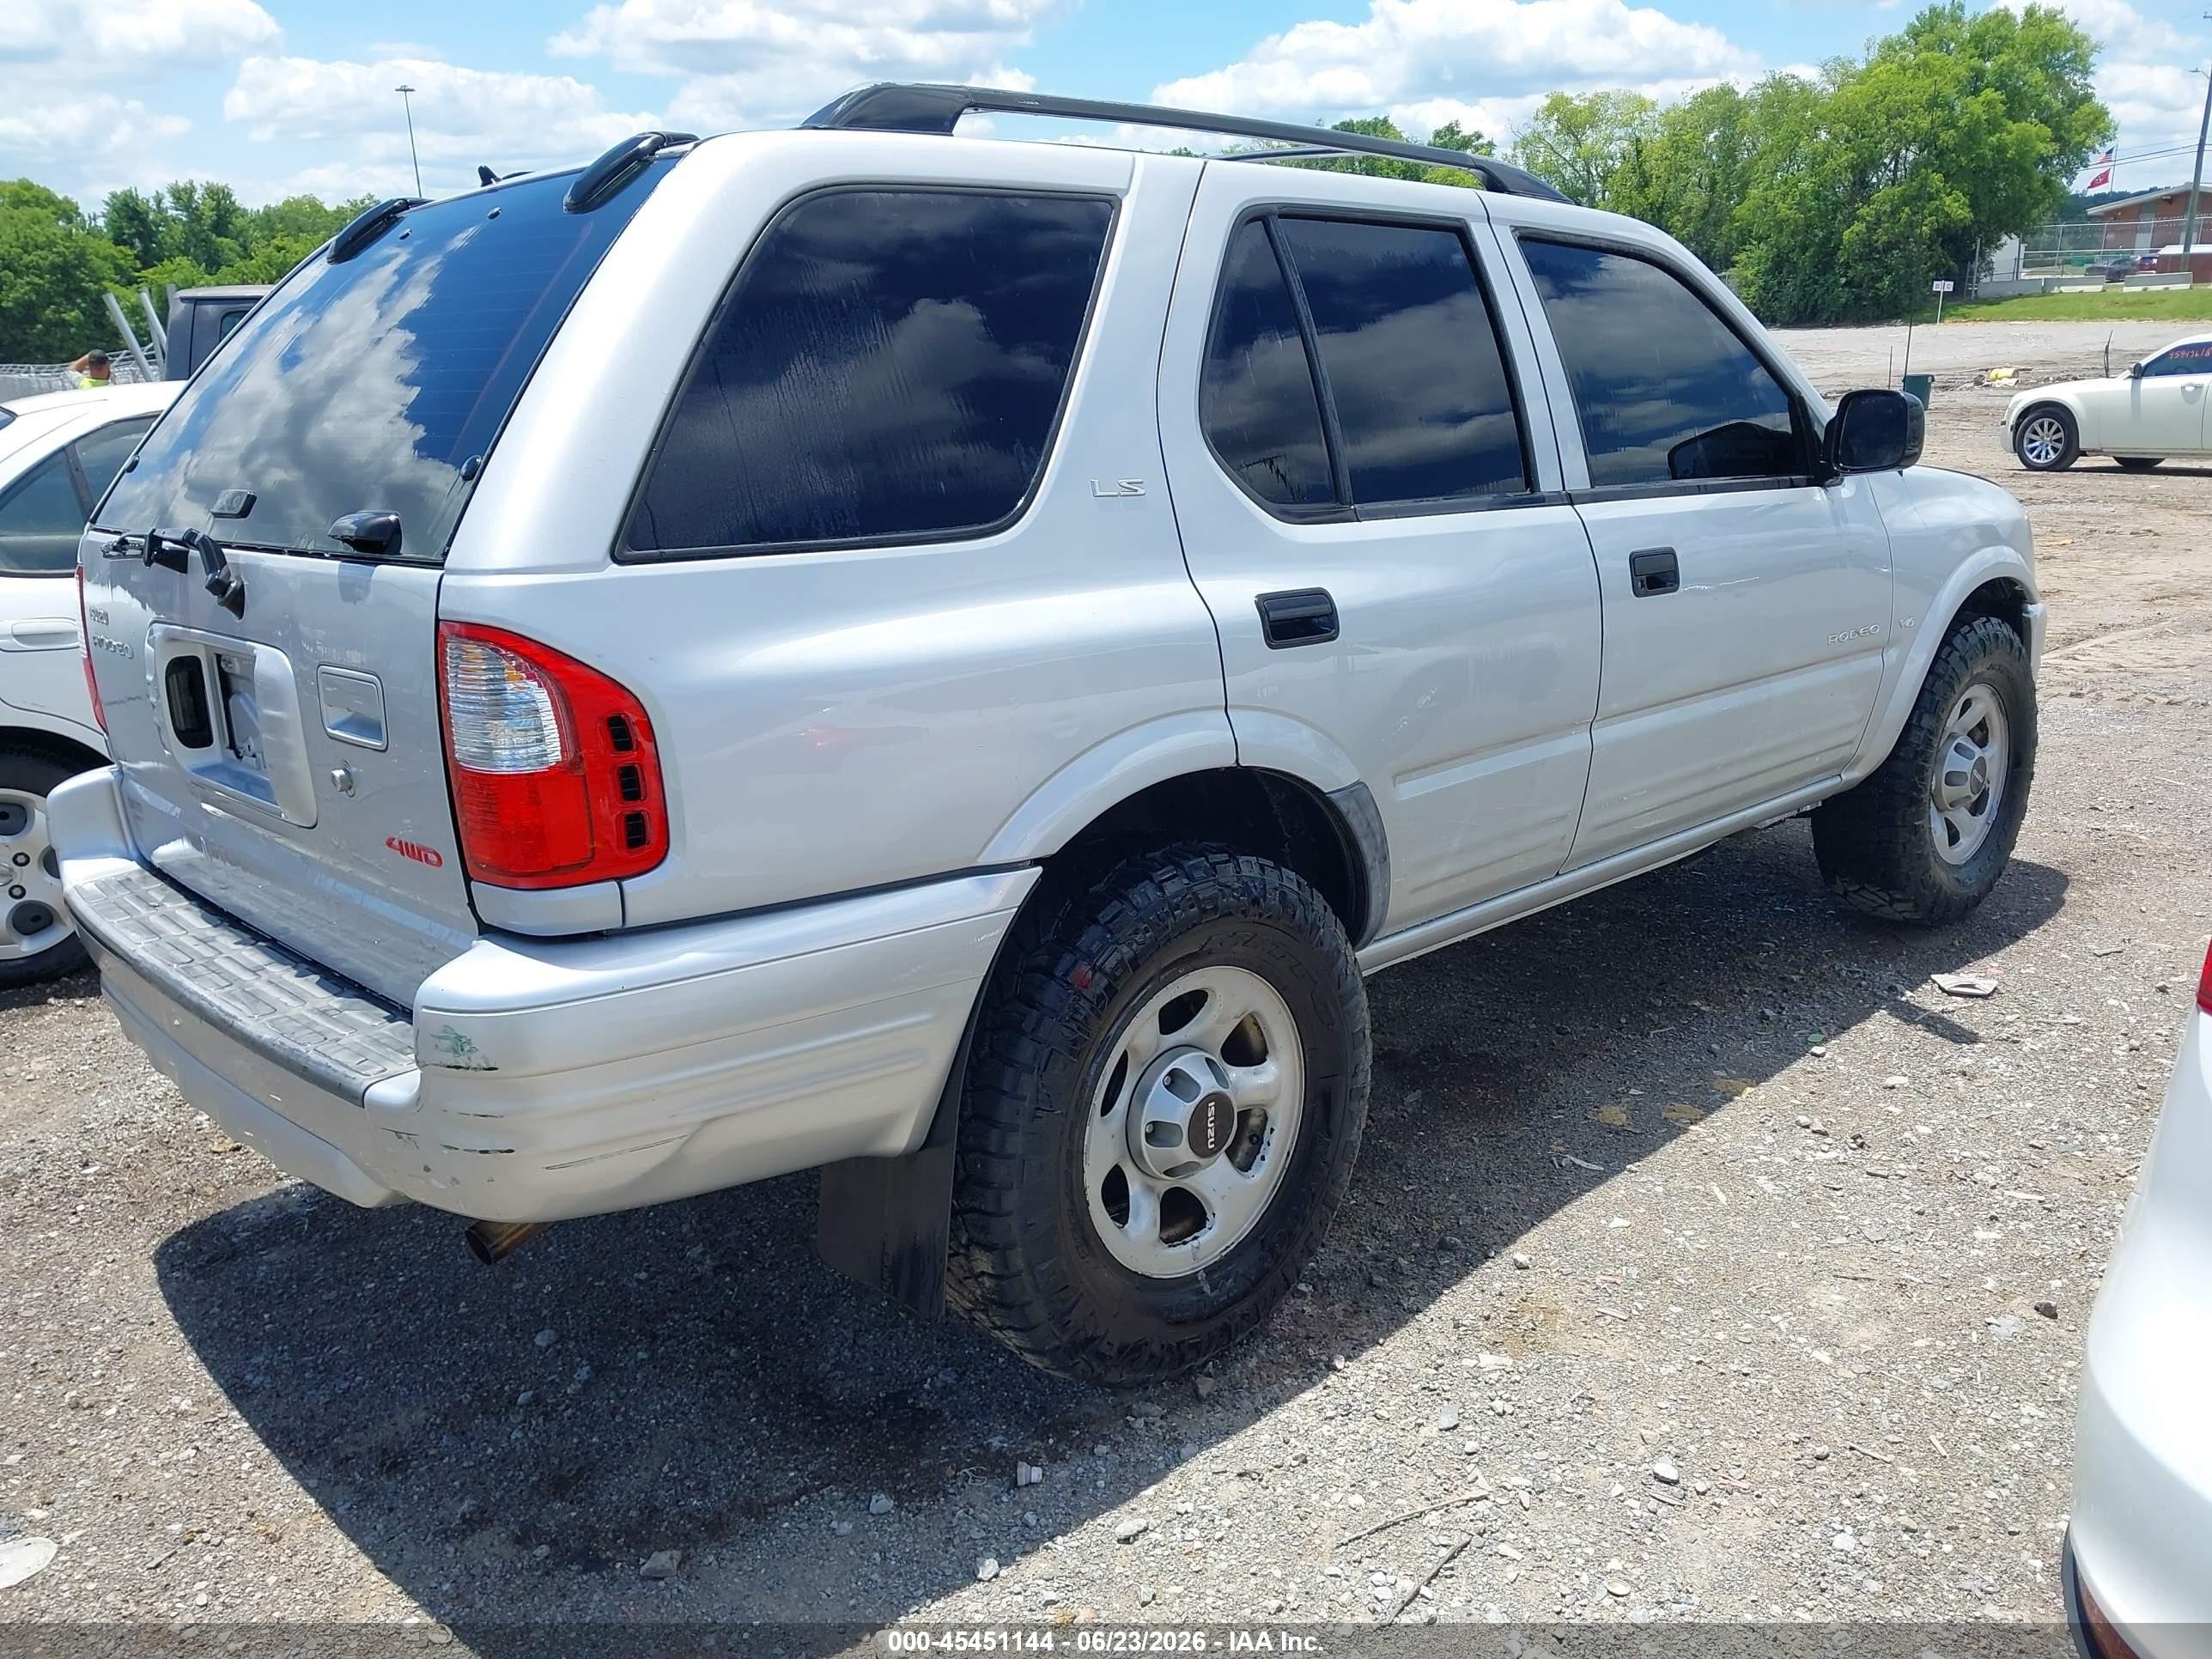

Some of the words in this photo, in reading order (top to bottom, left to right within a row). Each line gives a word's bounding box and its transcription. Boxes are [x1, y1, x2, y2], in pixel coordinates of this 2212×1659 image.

[1090, 477, 1146, 498] LS
[1899, 616, 1916, 630] V6
[1826, 624, 1882, 645] RODEO
[385, 836, 443, 867] 4WD
[1207, 1101, 1216, 1149] ISUZU
